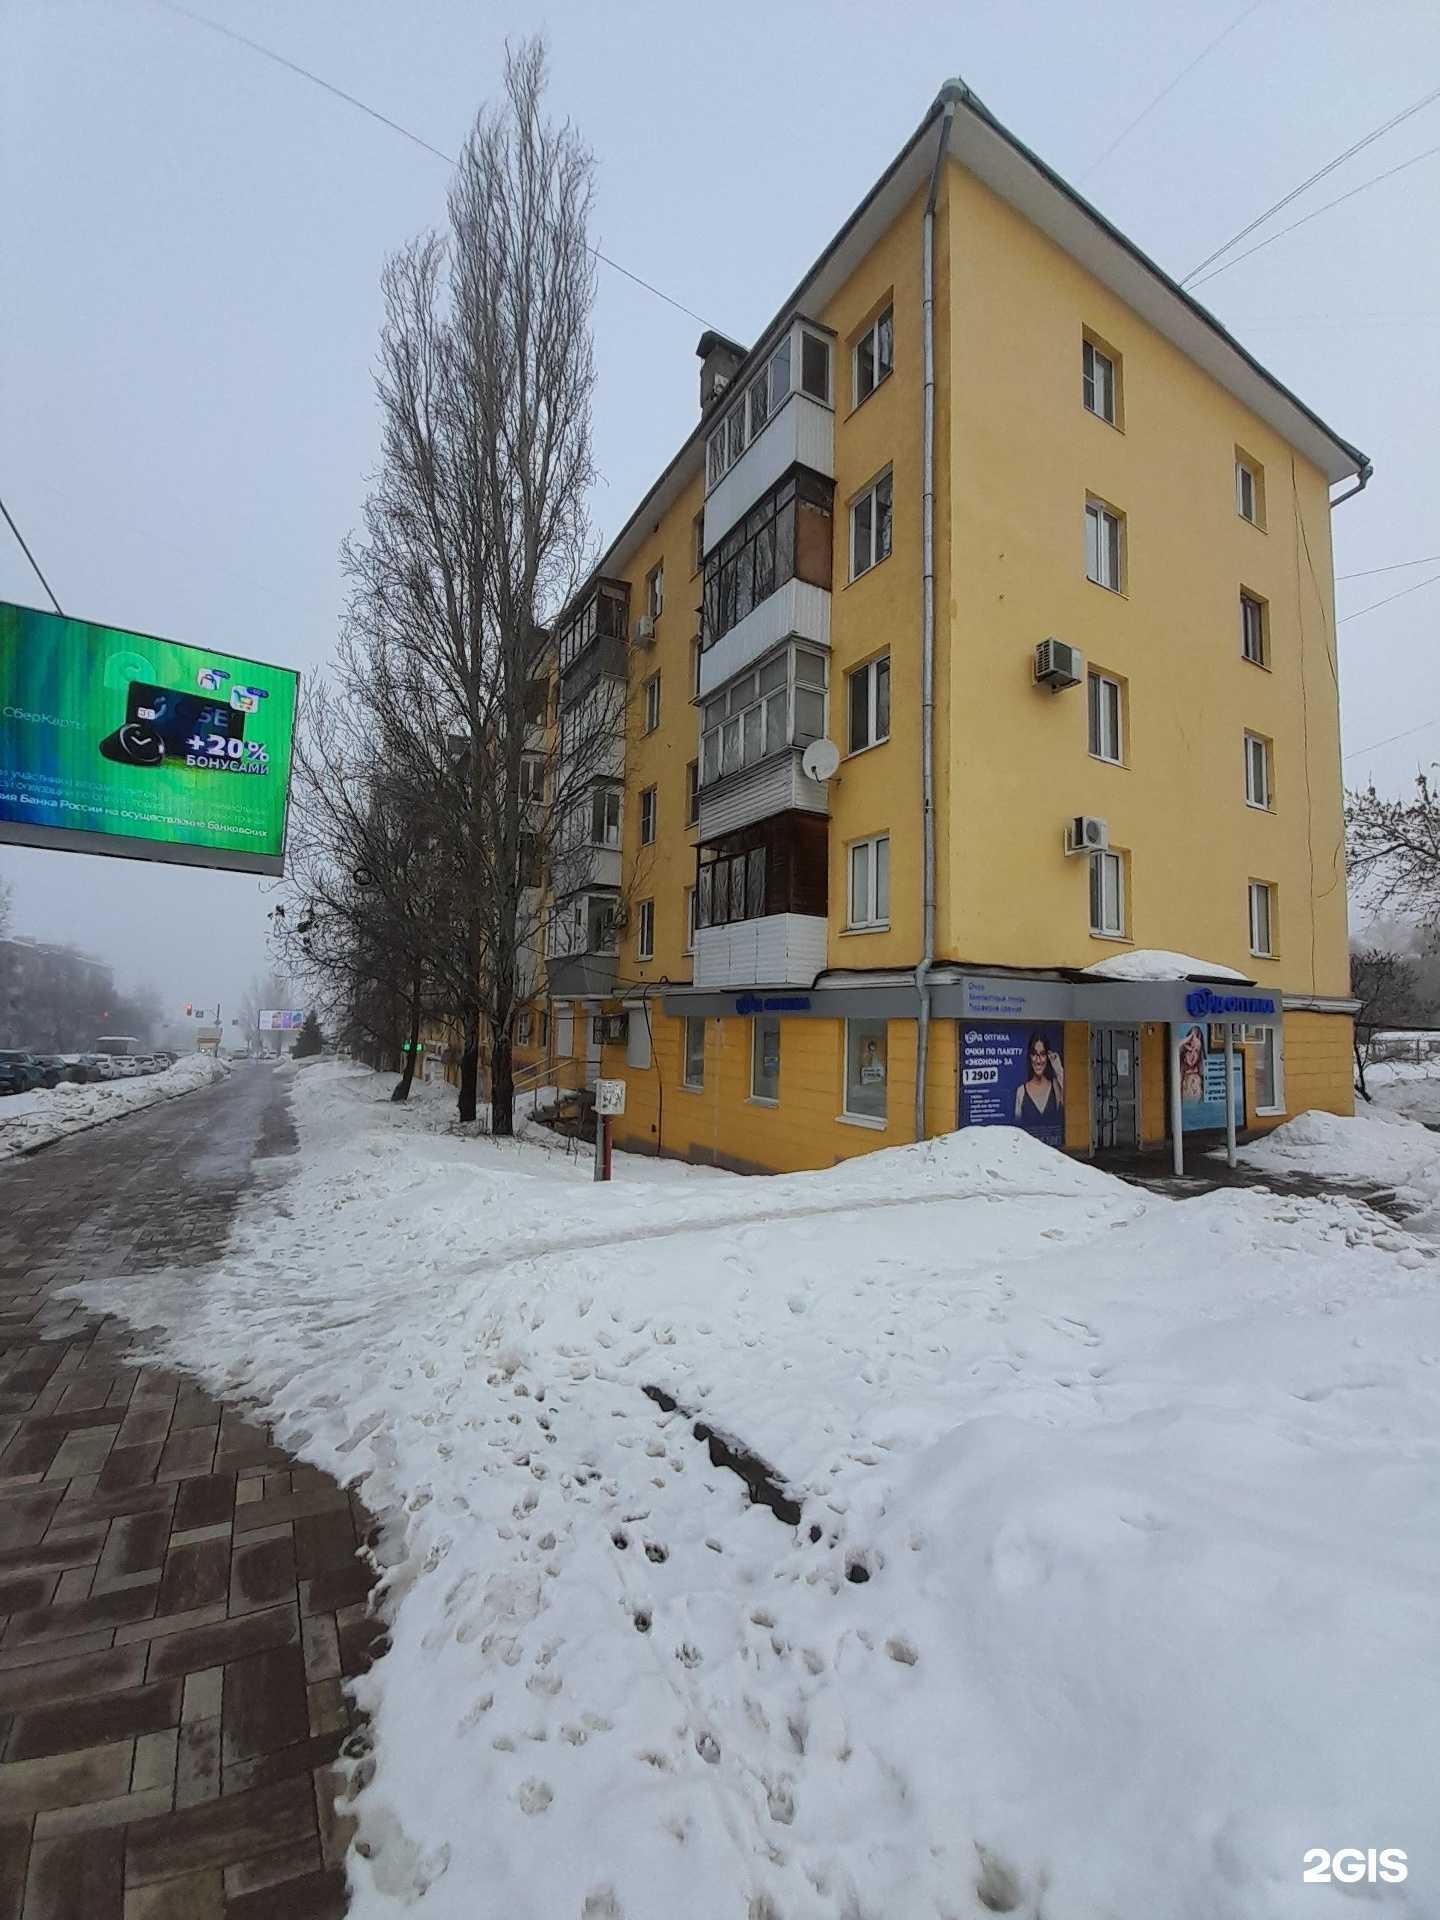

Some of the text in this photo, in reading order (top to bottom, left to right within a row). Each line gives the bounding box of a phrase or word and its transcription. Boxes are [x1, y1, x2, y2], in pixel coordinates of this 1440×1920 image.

[185, 733, 270, 763] +20%
[186, 754, 269, 775] БОНУСАМИ
[20, 793, 58, 808] Банка
[60, 799, 103, 814] России
[983, 1033, 1010, 1041] ОПТИКА
[964, 1047, 1023, 1056] ОЧКИ ПО ПАКЕТУ
[1003, 1057, 1013, 1065] ЗА
